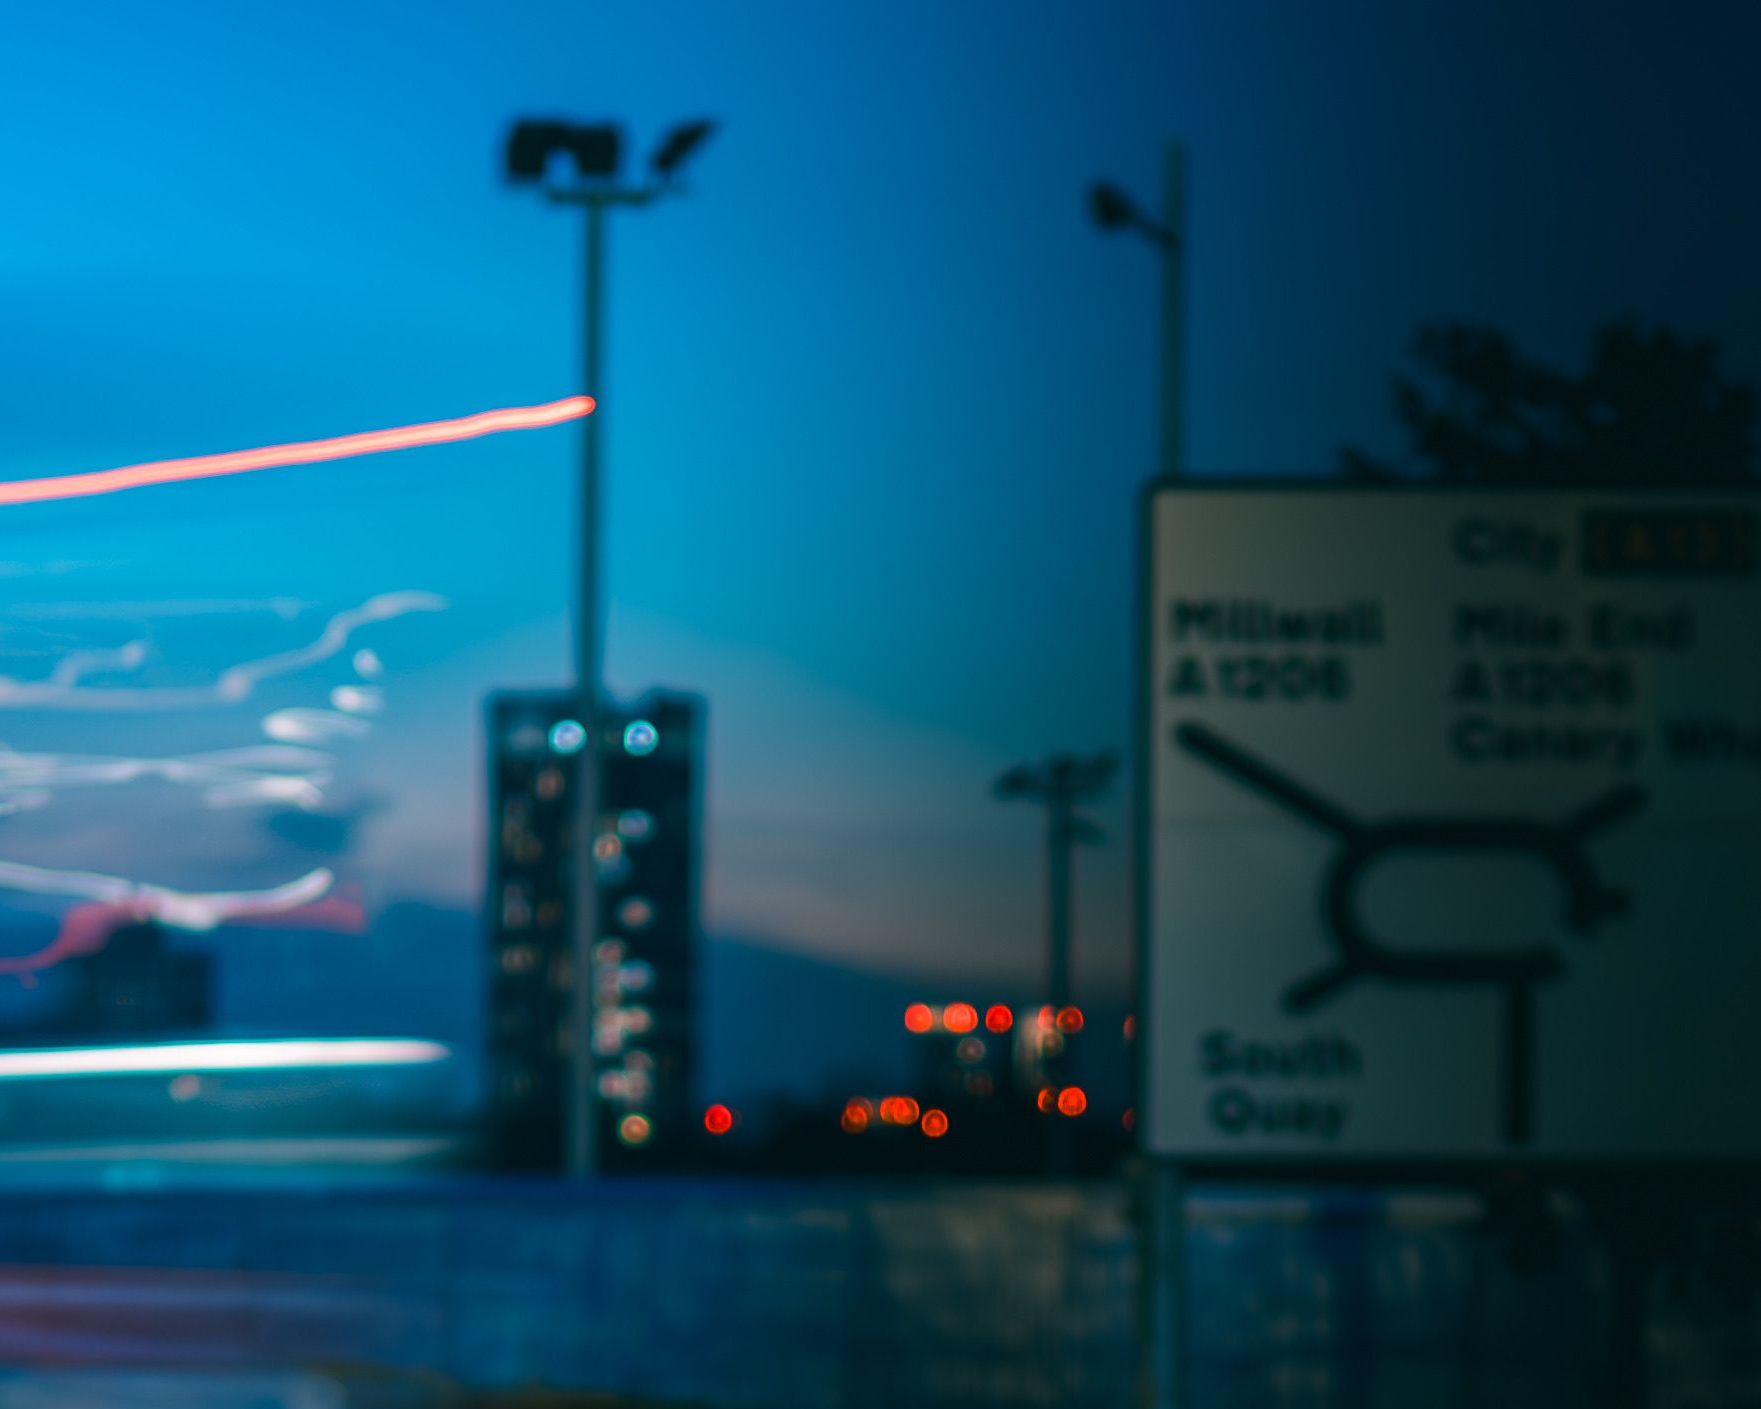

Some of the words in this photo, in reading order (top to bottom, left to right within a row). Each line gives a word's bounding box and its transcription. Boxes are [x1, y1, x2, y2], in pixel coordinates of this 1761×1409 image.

[1455, 520, 1564, 573] City
[1172, 600, 1387, 645] Millwall
[1455, 607, 1569, 648] Mile
[1590, 605, 1693, 649] End
[1169, 657, 1351, 699] A1206
[1452, 665, 1637, 708] A1206
[1454, 720, 1644, 772] Canary
[1200, 1031, 1362, 1076] South
[1210, 1086, 1345, 1140] Quay
